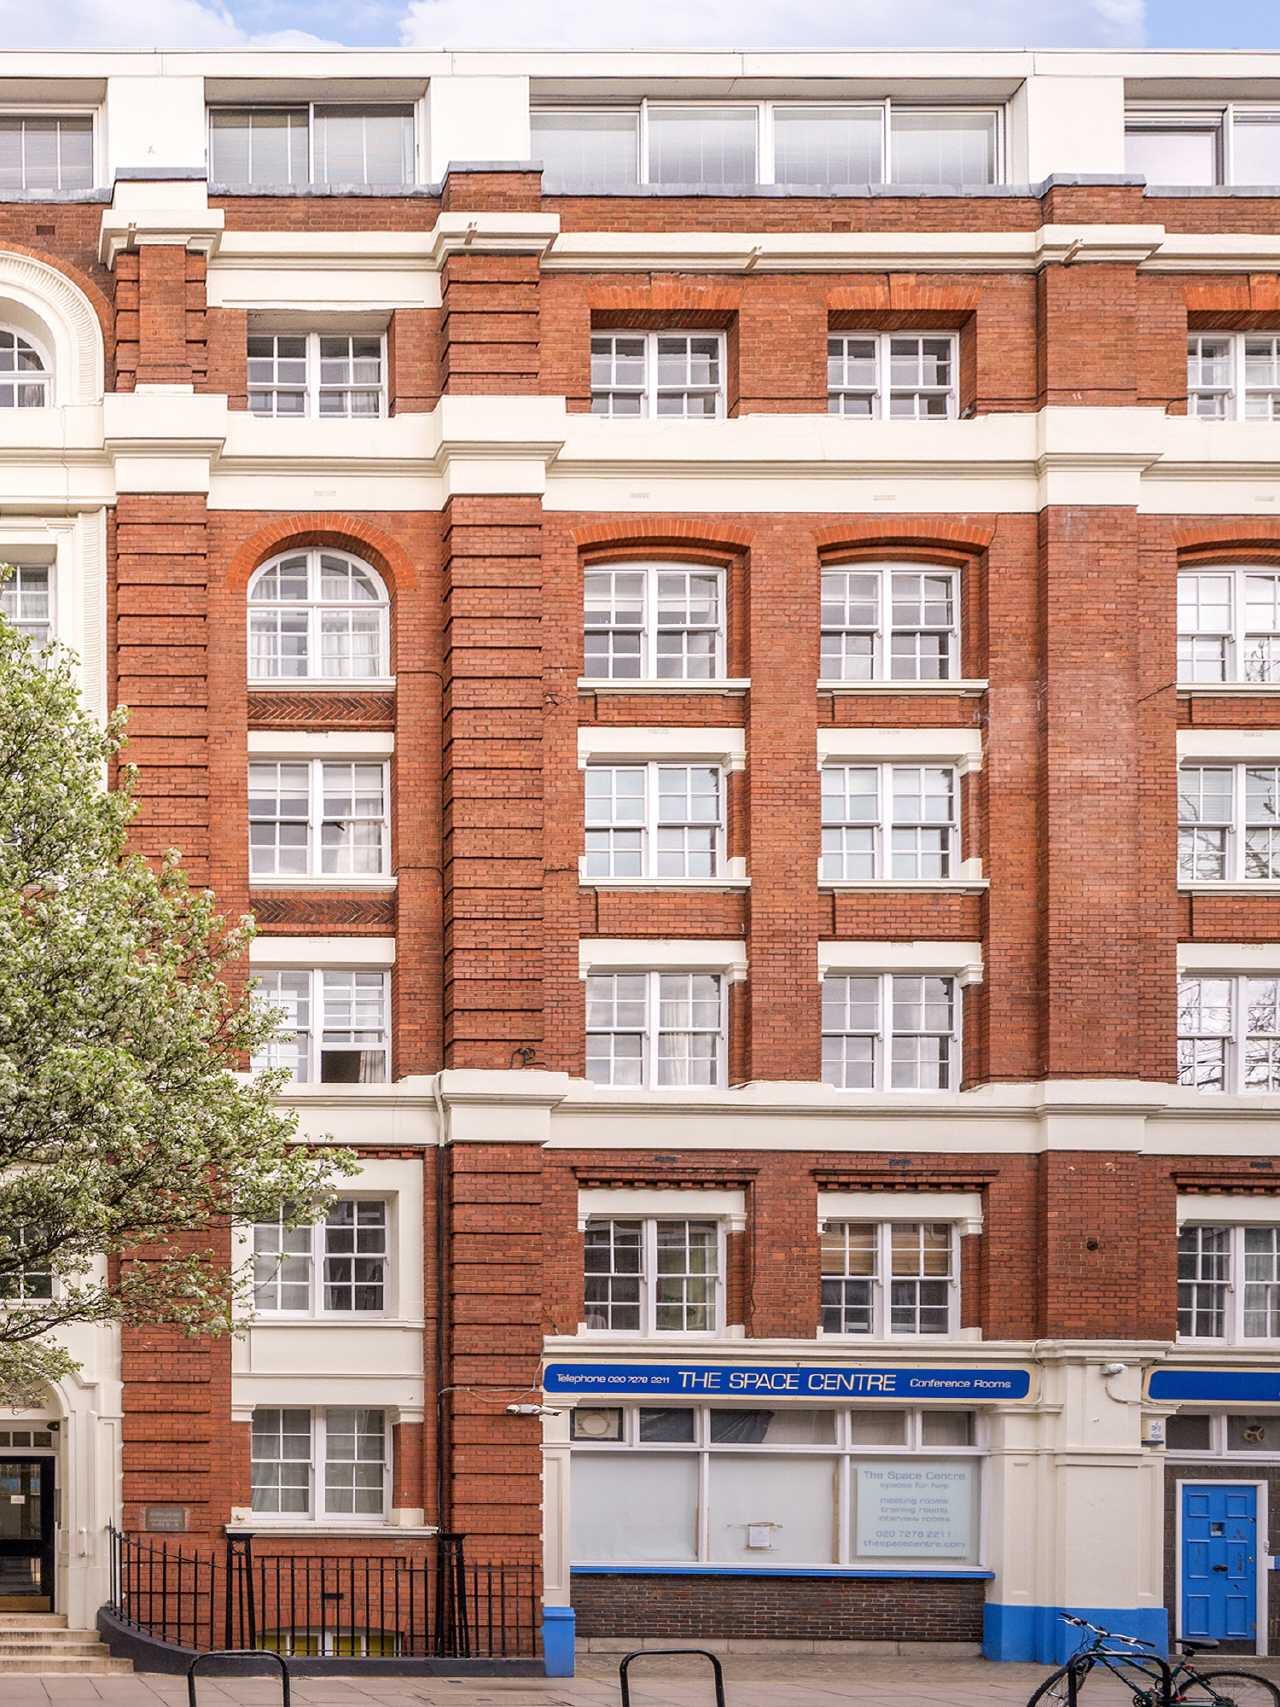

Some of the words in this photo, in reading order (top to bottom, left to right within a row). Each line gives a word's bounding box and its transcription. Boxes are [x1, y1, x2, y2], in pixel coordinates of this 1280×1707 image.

[556, 1373, 606, 1384] Telephone
[677, 1371, 722, 1388] THE
[728, 1371, 800, 1390] SPACE
[807, 1373, 897, 1392] CENTRE
[909, 1377, 971, 1389] Conference
[973, 1378, 1012, 1389] Rooms
[887, 1470, 923, 1482] Space
[926, 1471, 966, 1481] Centre
